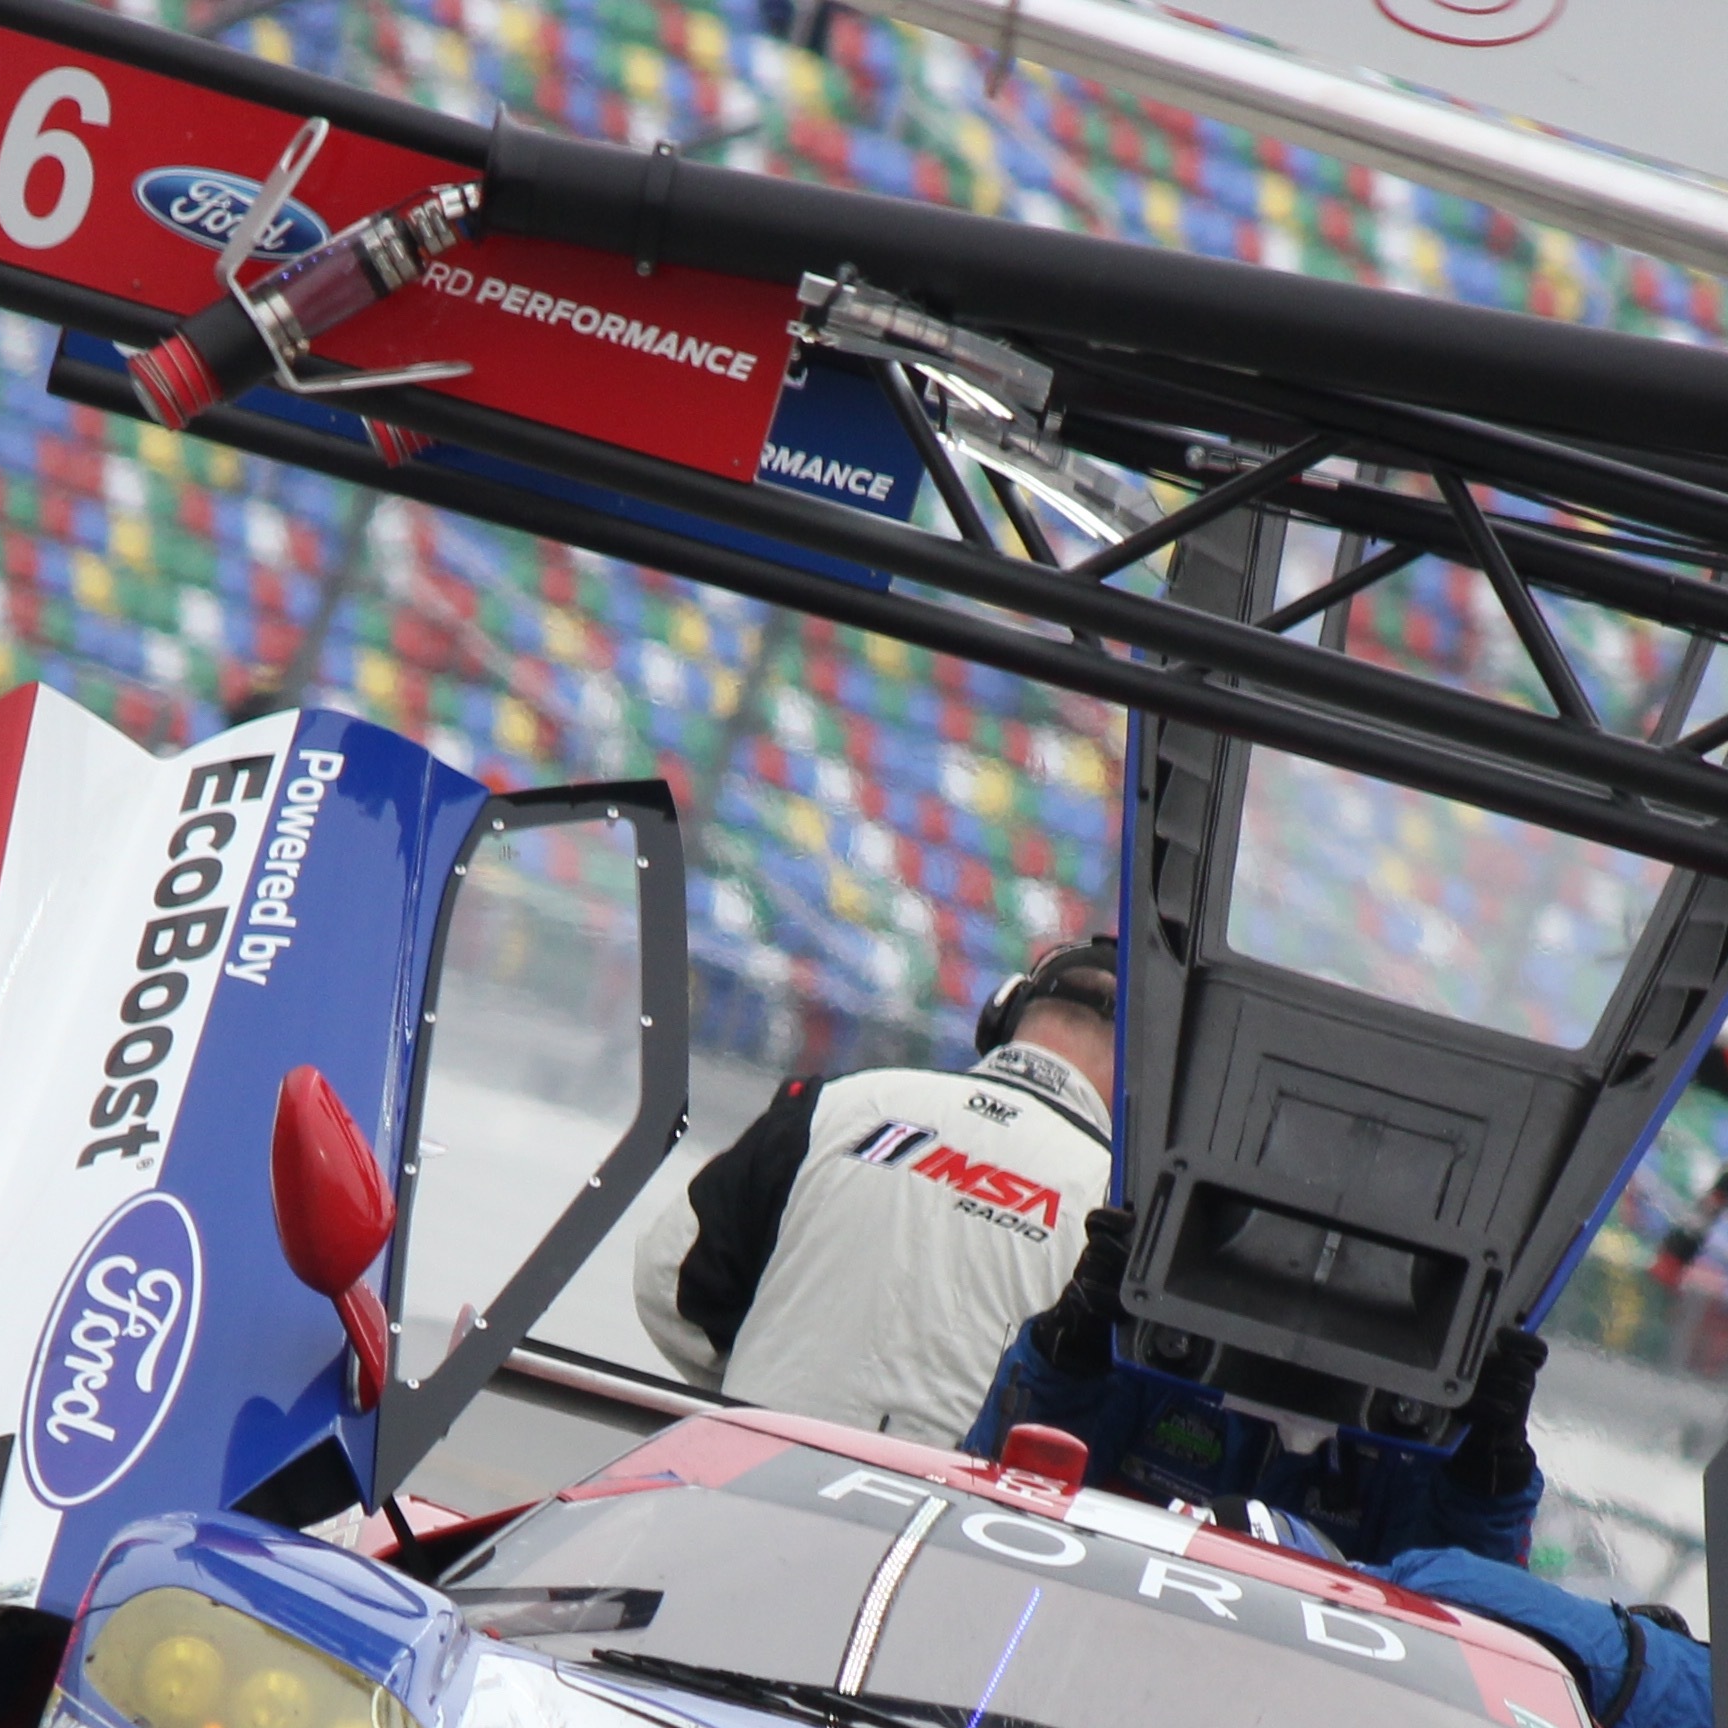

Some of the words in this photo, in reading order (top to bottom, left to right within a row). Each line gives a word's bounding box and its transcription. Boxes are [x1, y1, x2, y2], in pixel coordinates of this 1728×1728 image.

[169, 179, 294, 251] Fod
[422, 261, 475, 298] RD
[475, 277, 758, 382] PERFORMANCE
[760, 441, 895, 502] RMANCE
[248, 749, 346, 928] Powered
[76, 752, 276, 1170] EcoBoost
[224, 933, 291, 987] by
[909, 1143, 1062, 1231] IMSA
[953, 1198, 1050, 1244] RADIO
[46, 1254, 183, 1445] Ford
[817, 1469, 1406, 1662] FORD
